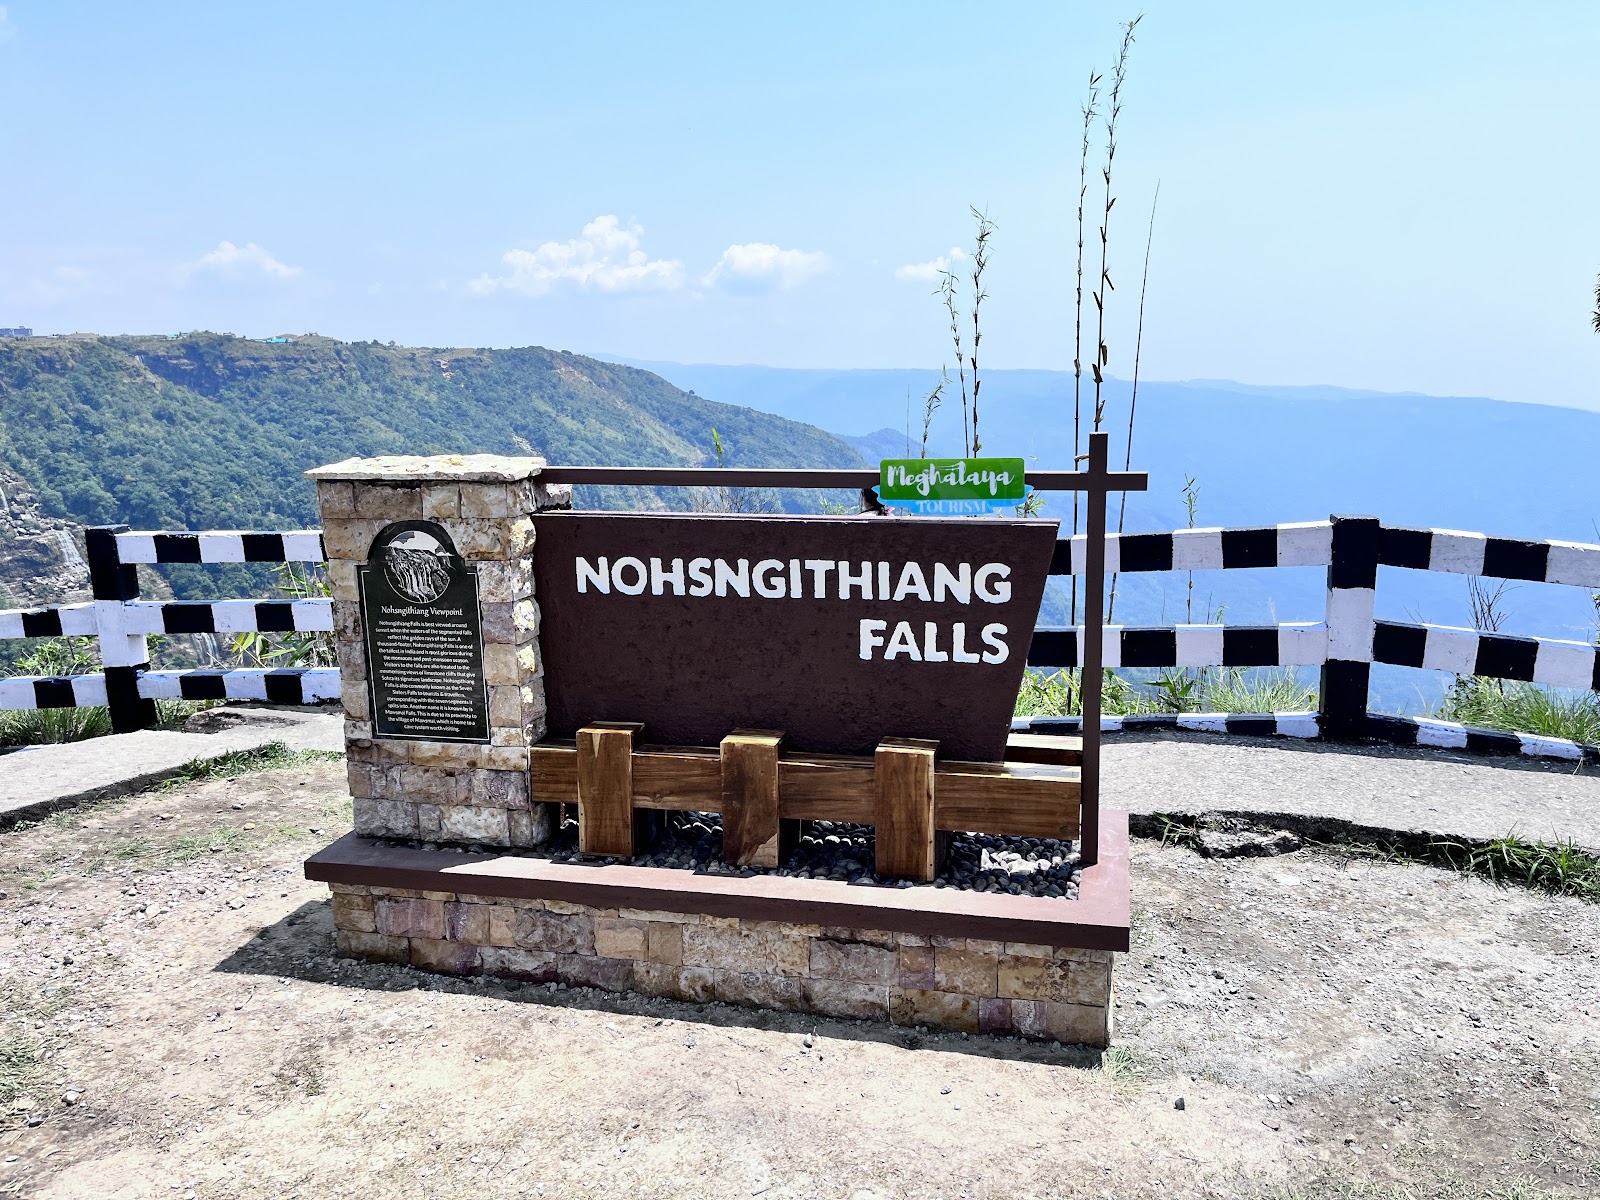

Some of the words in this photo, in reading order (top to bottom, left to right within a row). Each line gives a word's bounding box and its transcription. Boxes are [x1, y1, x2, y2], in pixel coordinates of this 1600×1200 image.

[887, 461, 1015, 496] Meghalaya
[916, 500, 986, 514] TOURISM
[576, 556, 1012, 604] NOHSNGITHIANG
[381, 605, 429, 617] Nohsngithiang
[430, 607, 463, 618] Viewpoint
[858, 618, 1010, 664] FALLS
